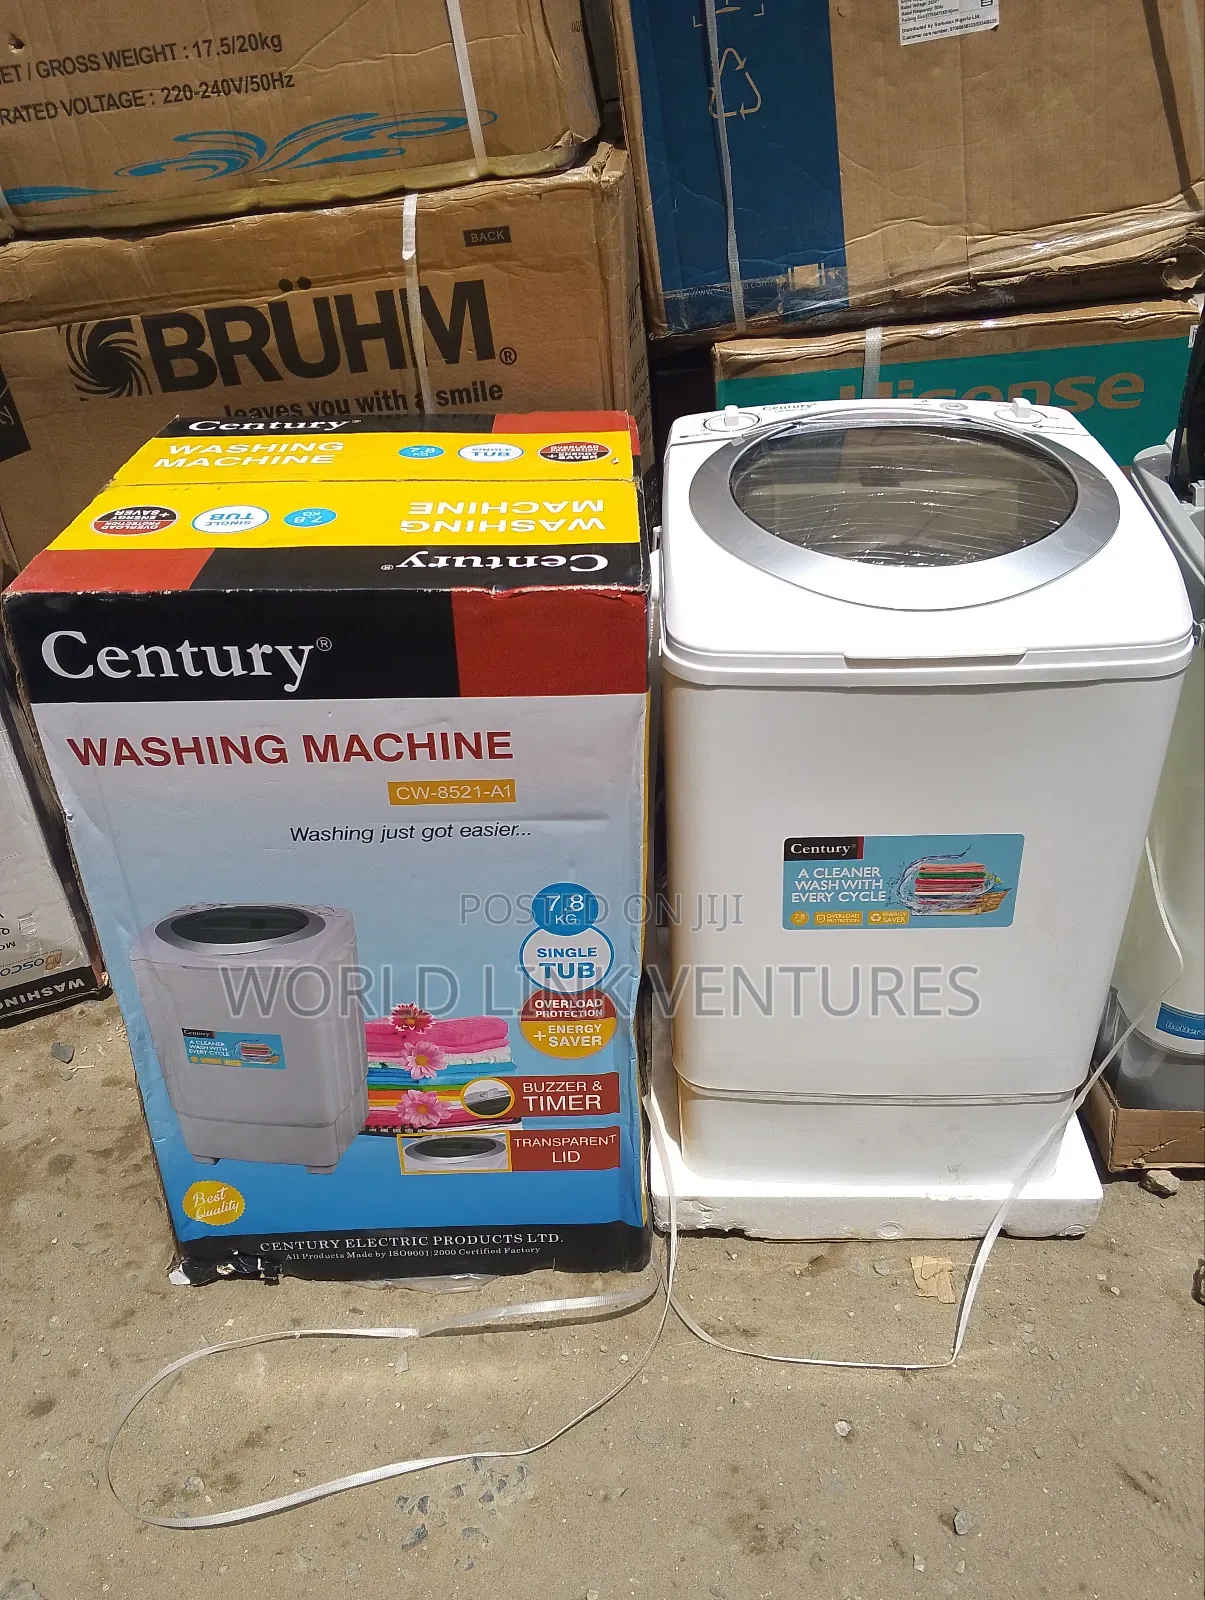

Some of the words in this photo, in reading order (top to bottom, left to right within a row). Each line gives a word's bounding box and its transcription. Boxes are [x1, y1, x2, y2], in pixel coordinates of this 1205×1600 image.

[901, 24, 927, 34] Distributed
[0, 64, 21, 84] ET
[35, 53, 101, 79] GROSS
[102, 43, 177, 69] WEIGHT
[192, 32, 283, 59] 17.5/20kg
[0, 101, 58, 125] RATED
[60, 89, 146, 117] VOLTAGE
[160, 72, 295, 104] 220-240V/50Hz
[470, 230, 505, 243] BACK
[307, 399, 350, 417] you
[349, 389, 408, 413] with
[436, 381, 505, 408] smile
[168, 441, 345, 455] WASHING
[152, 454, 335, 469] MACHINE
[408, 500, 604, 515] MACHINE
[209, 512, 254, 521] TUB
[100, 523, 160, 531] OVERLOAD
[399, 518, 606, 533] WASHING
[66, 735, 288, 766] WASHING
[302, 732, 514, 763] MACHINE
[396, 784, 512, 801] CW-8521-A1
[290, 826, 374, 844] Washing
[380, 824, 415, 843] just
[421, 826, 454, 842] got
[459, 823, 532, 839] easier...
[798, 868, 809, 878] A
[813, 867, 881, 879] CLEANER
[795, 880, 840, 891] WASH
[841, 879, 883, 890] WITH
[546, 894, 584, 912] 7.8
[791, 892, 837, 903] EVERY
[838, 891, 886, 902] CYCLE
[555, 914, 577, 925] KG
[536, 947, 598, 959] SINGLE
[538, 961, 596, 980] TUB
[0, 978, 86, 1010] WASHIN
[534, 998, 603, 1010] OVERLOAD
[535, 1009, 603, 1018] PROTECTION
[548, 1024, 602, 1034] ENERGY
[548, 1035, 602, 1047] SAVER
[522, 1081, 587, 1093] BUZZER
[592, 1080, 603, 1092] &
[522, 1095, 601, 1112] TIMER
[513, 1134, 617, 1148] TRANSPARENT
[552, 1150, 581, 1163] LID
[190, 1187, 228, 1210] Best
[195, 1200, 239, 1220] Quality
[259, 1238, 340, 1252] CENTURY
[345, 1236, 429, 1249] ELECTRIC
[433, 1233, 523, 1246] PRODUCTS
[526, 1233, 564, 1244] LTD.
[285, 1252, 300, 1260] All
[302, 1251, 345, 1260] Products
[347, 1251, 373, 1259] Made
[375, 1250, 386, 1259] by
[459, 1247, 502, 1256] Certified
[504, 1246, 541, 1256] Factory
